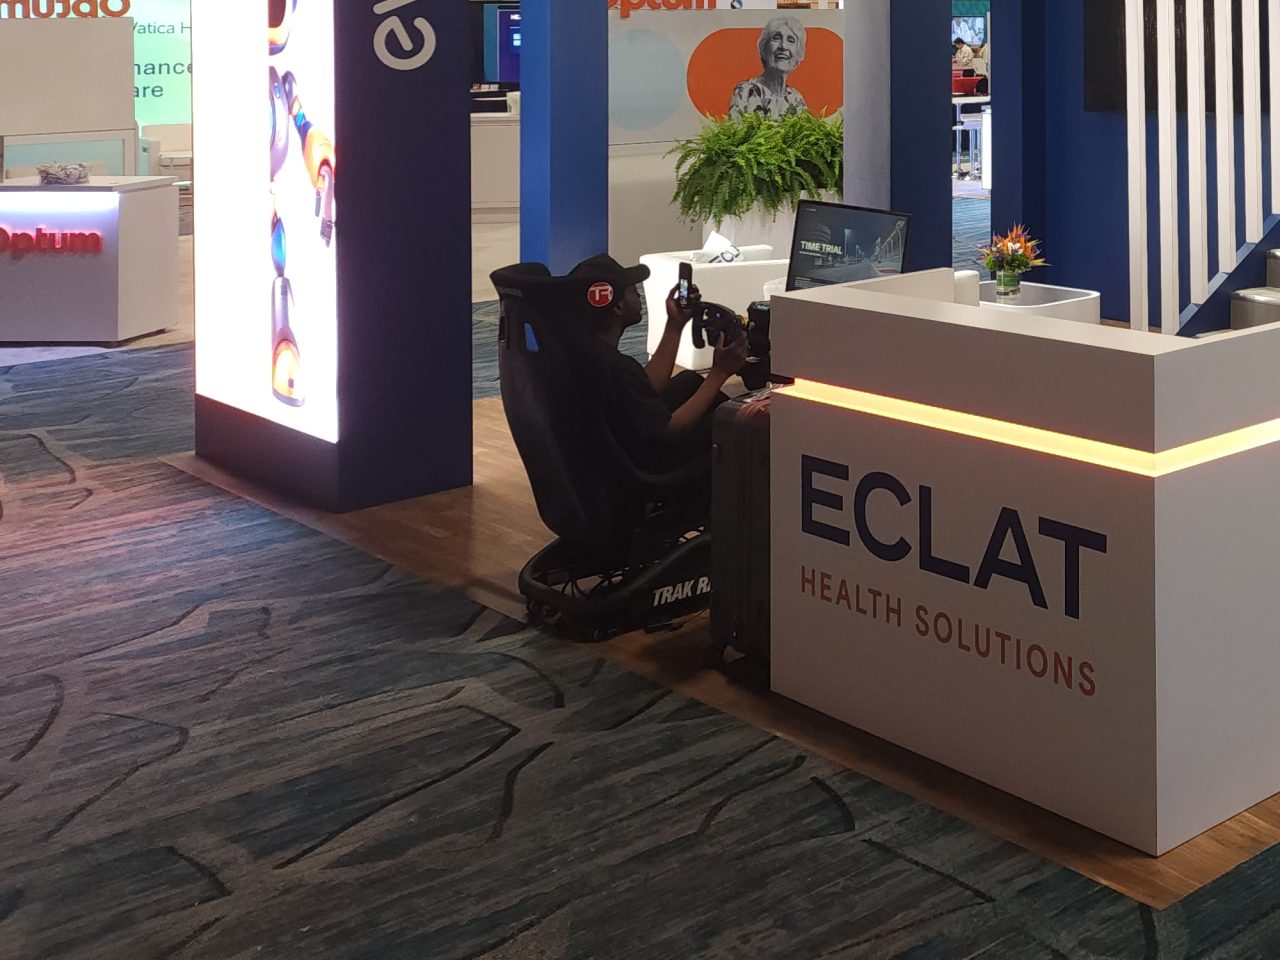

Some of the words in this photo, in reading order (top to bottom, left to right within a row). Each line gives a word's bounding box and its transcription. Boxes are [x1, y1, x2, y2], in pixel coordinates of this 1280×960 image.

[800, 240, 821, 253] TIME
[821, 243, 843, 256] TRIAL
[801, 453, 1108, 620] ECLAT
[653, 577, 696, 607] TRAK
[800, 565, 902, 628] HEALTH
[914, 604, 1097, 697] SOLUTIONS
